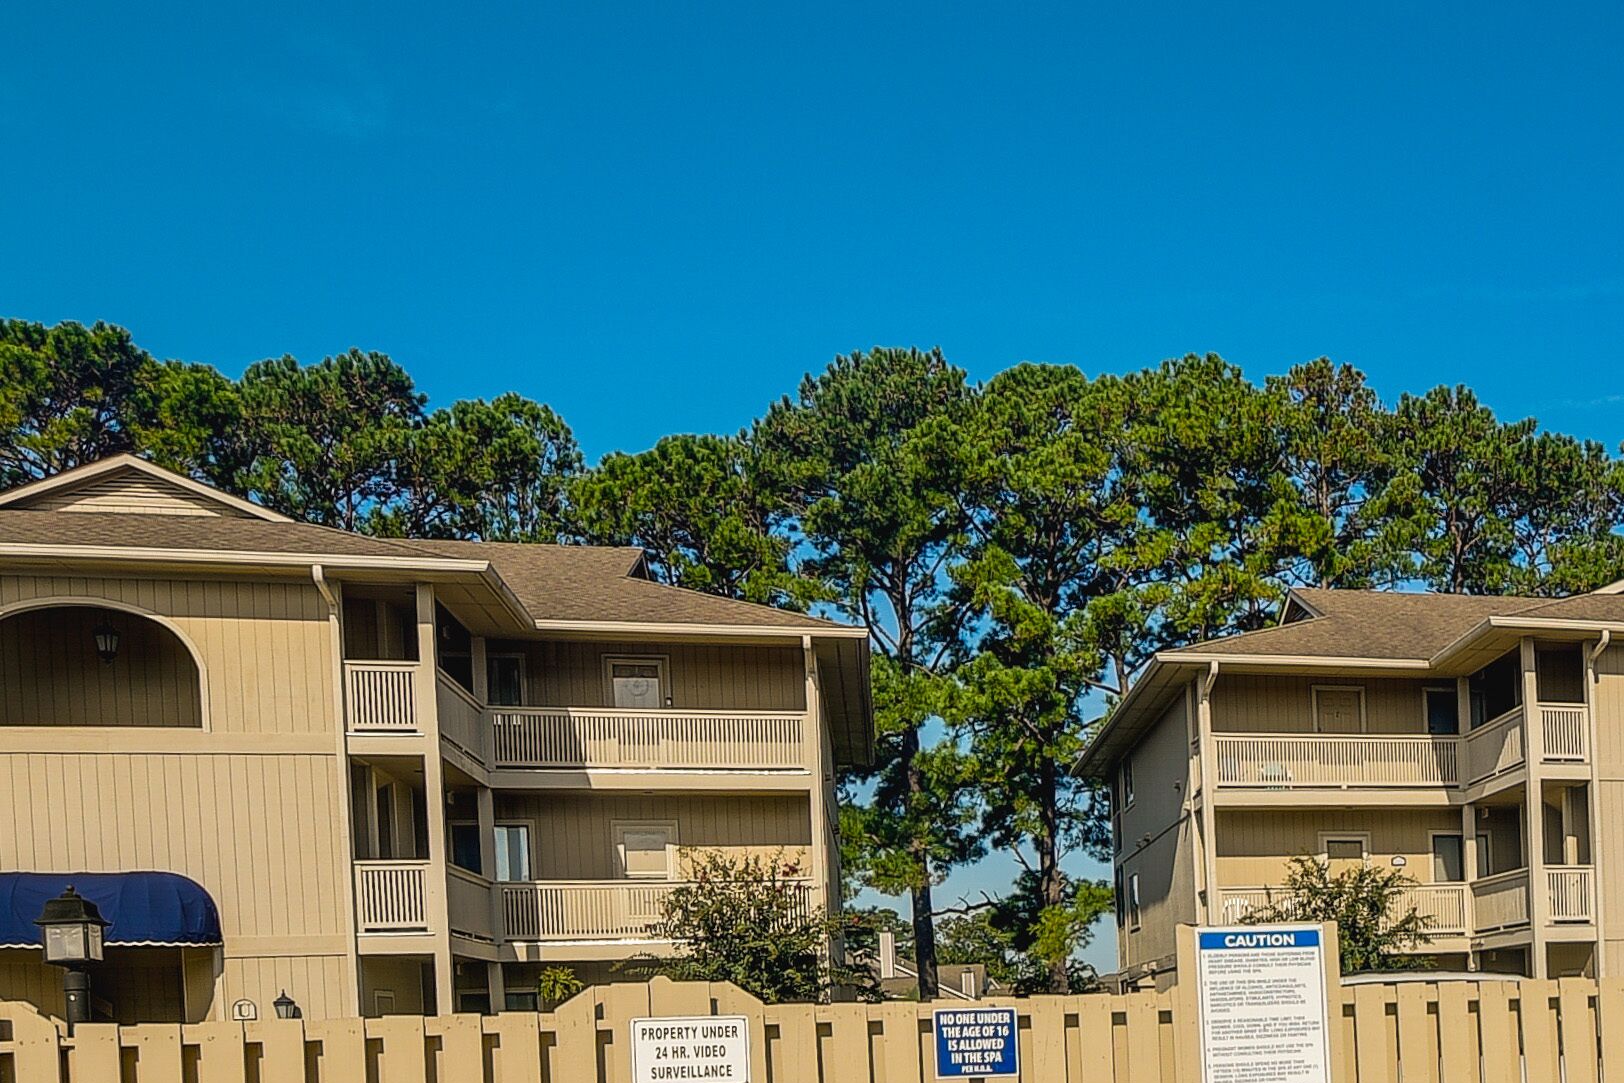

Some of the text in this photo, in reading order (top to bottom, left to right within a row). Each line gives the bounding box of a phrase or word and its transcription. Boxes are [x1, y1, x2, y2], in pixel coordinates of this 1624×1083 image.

[1224, 934, 1295, 948] CAUTION
[237, 1003, 250, 1018] U
[940, 1012, 1010, 1025] NO ONE UNDER
[640, 1026, 738, 1040] PROPERTY UNDER
[942, 1026, 1010, 1038] THE AGE OF 16
[948, 1038, 1004, 1051] IS ALLOWED
[655, 1045, 727, 1060] 24 HR. VIDEO
[951, 1052, 1003, 1064] IN THE SPA
[650, 1064, 733, 1080] SURVEILLANCE
